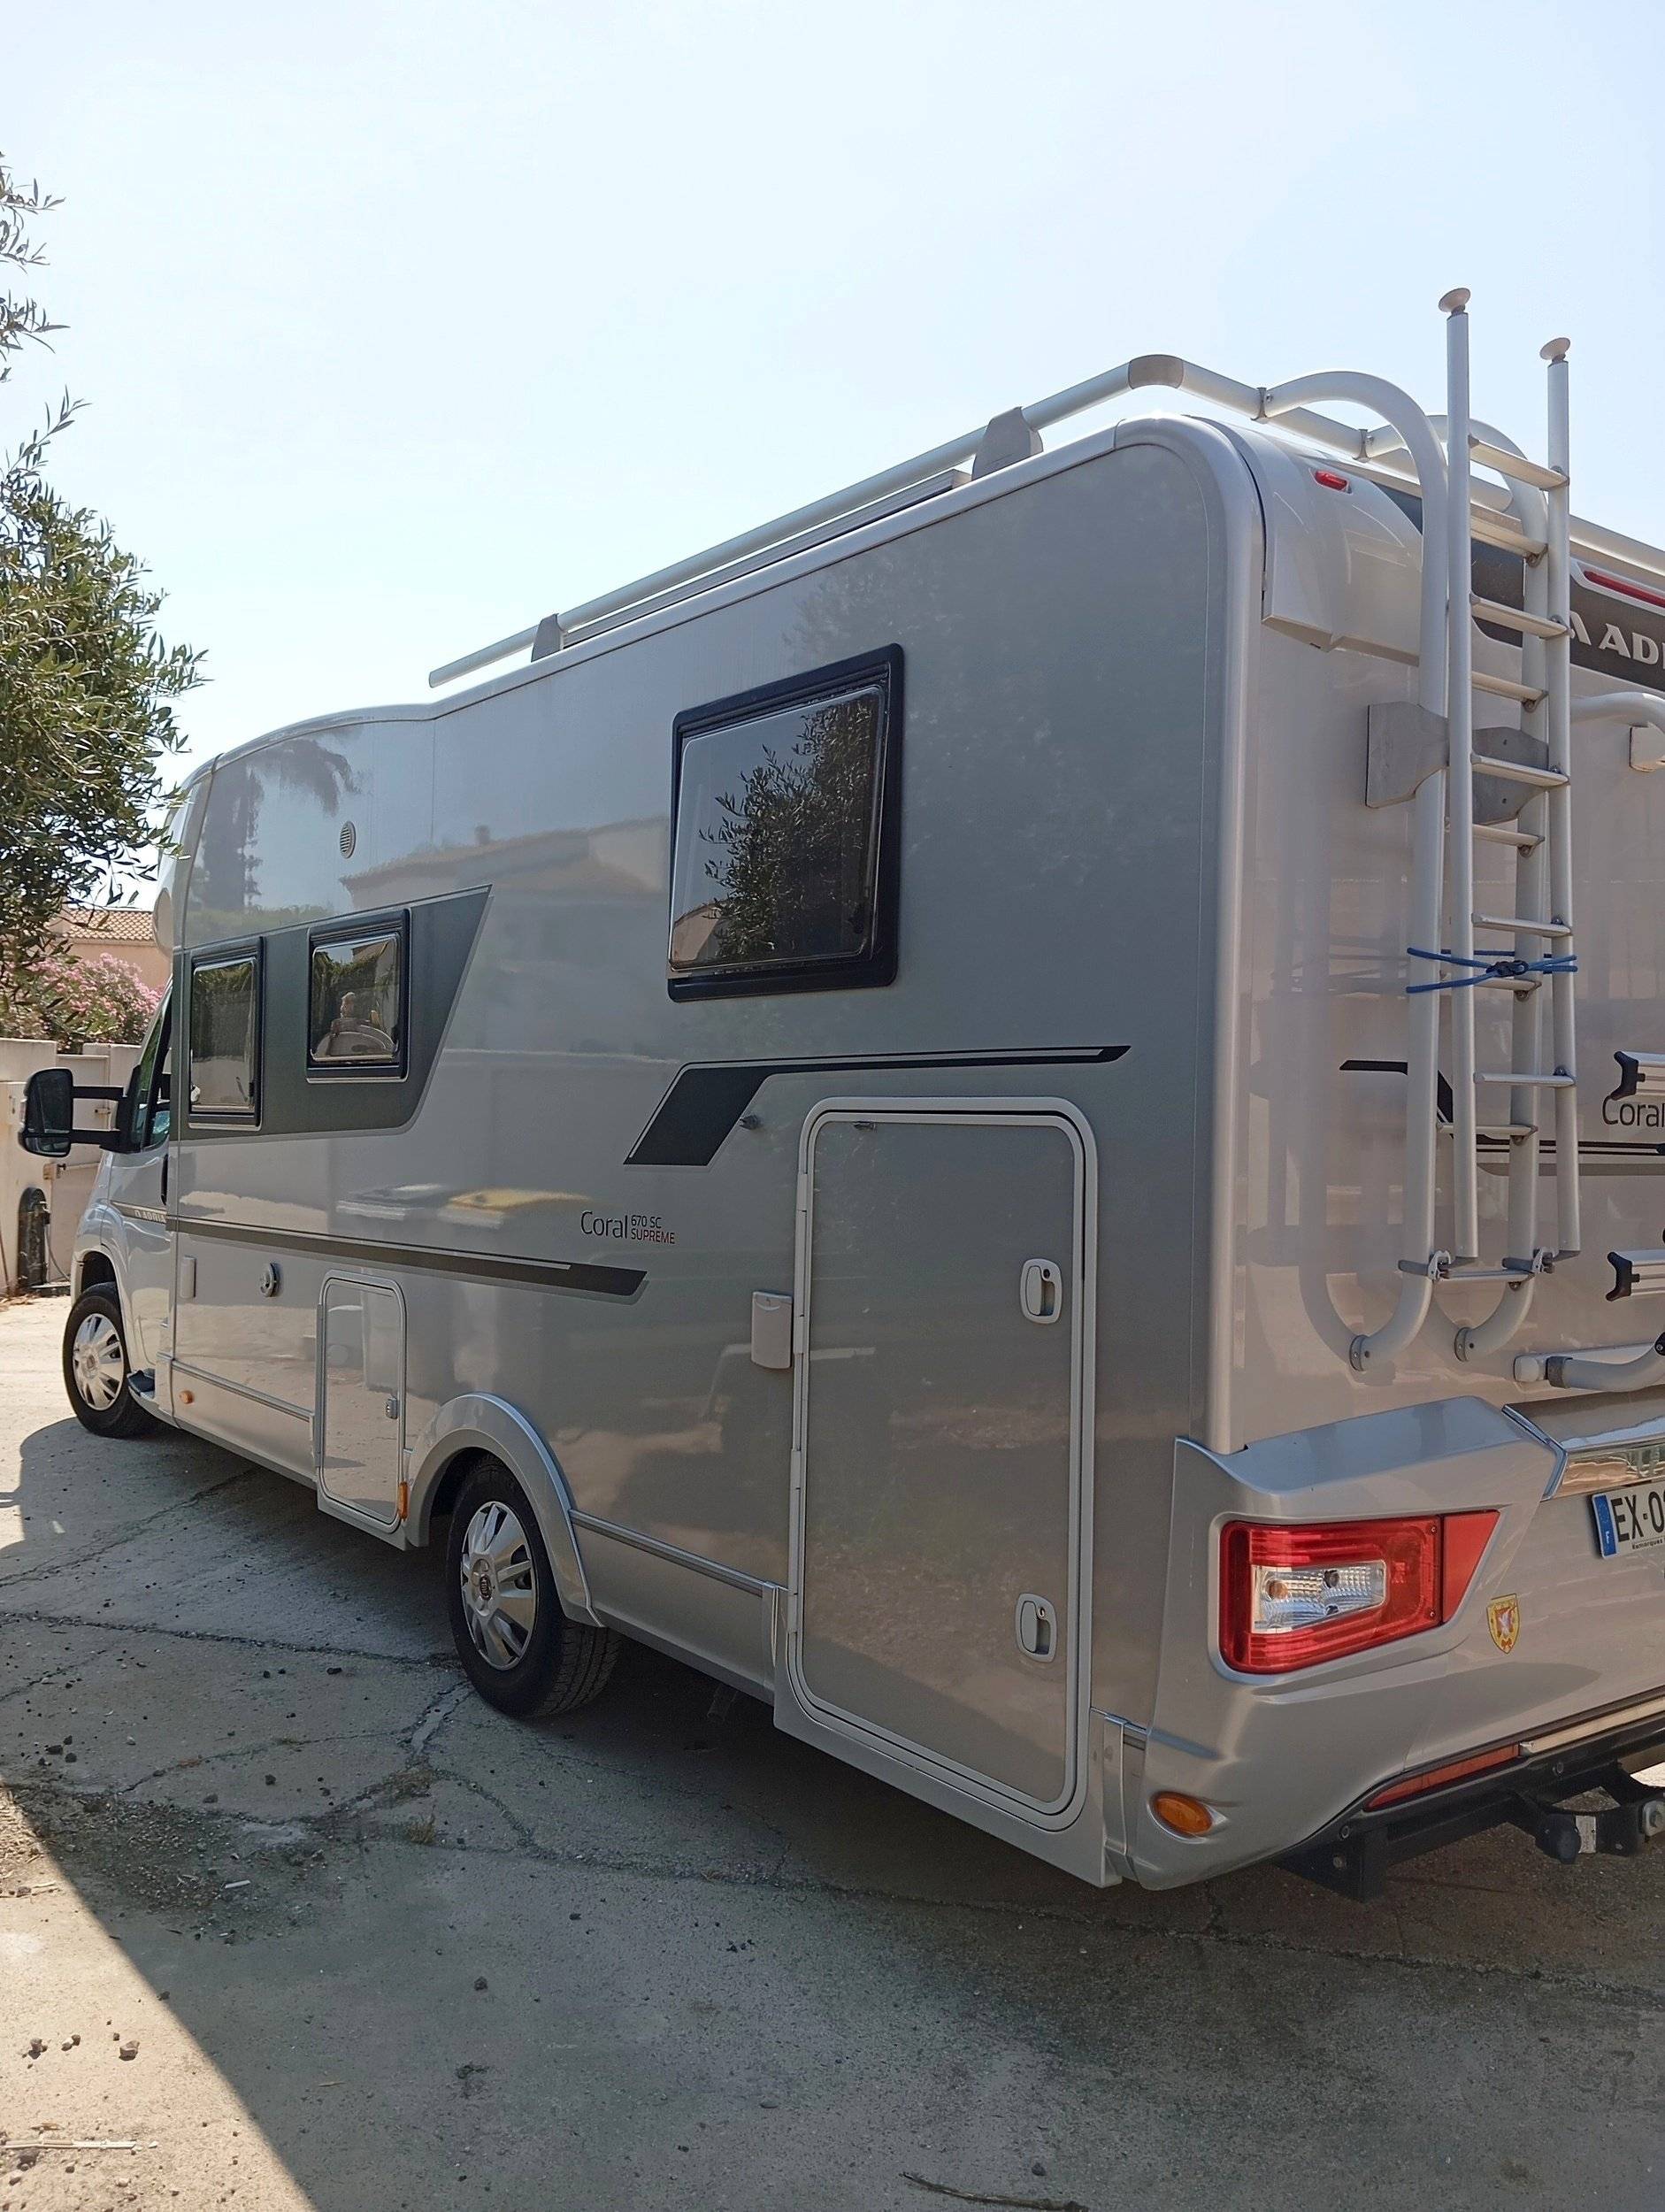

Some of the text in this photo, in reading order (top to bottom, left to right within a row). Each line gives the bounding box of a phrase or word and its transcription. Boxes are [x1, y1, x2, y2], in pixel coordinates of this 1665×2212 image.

[1599, 622, 1665, 670] AD
[1602, 1095, 1665, 1128] Coral
[580, 1210, 628, 1239] Coral
[631, 1214, 662, 1229] 670 SC
[631, 1227, 675, 1244] SUPREME
[1610, 1490, 1665, 1542] EX-0
